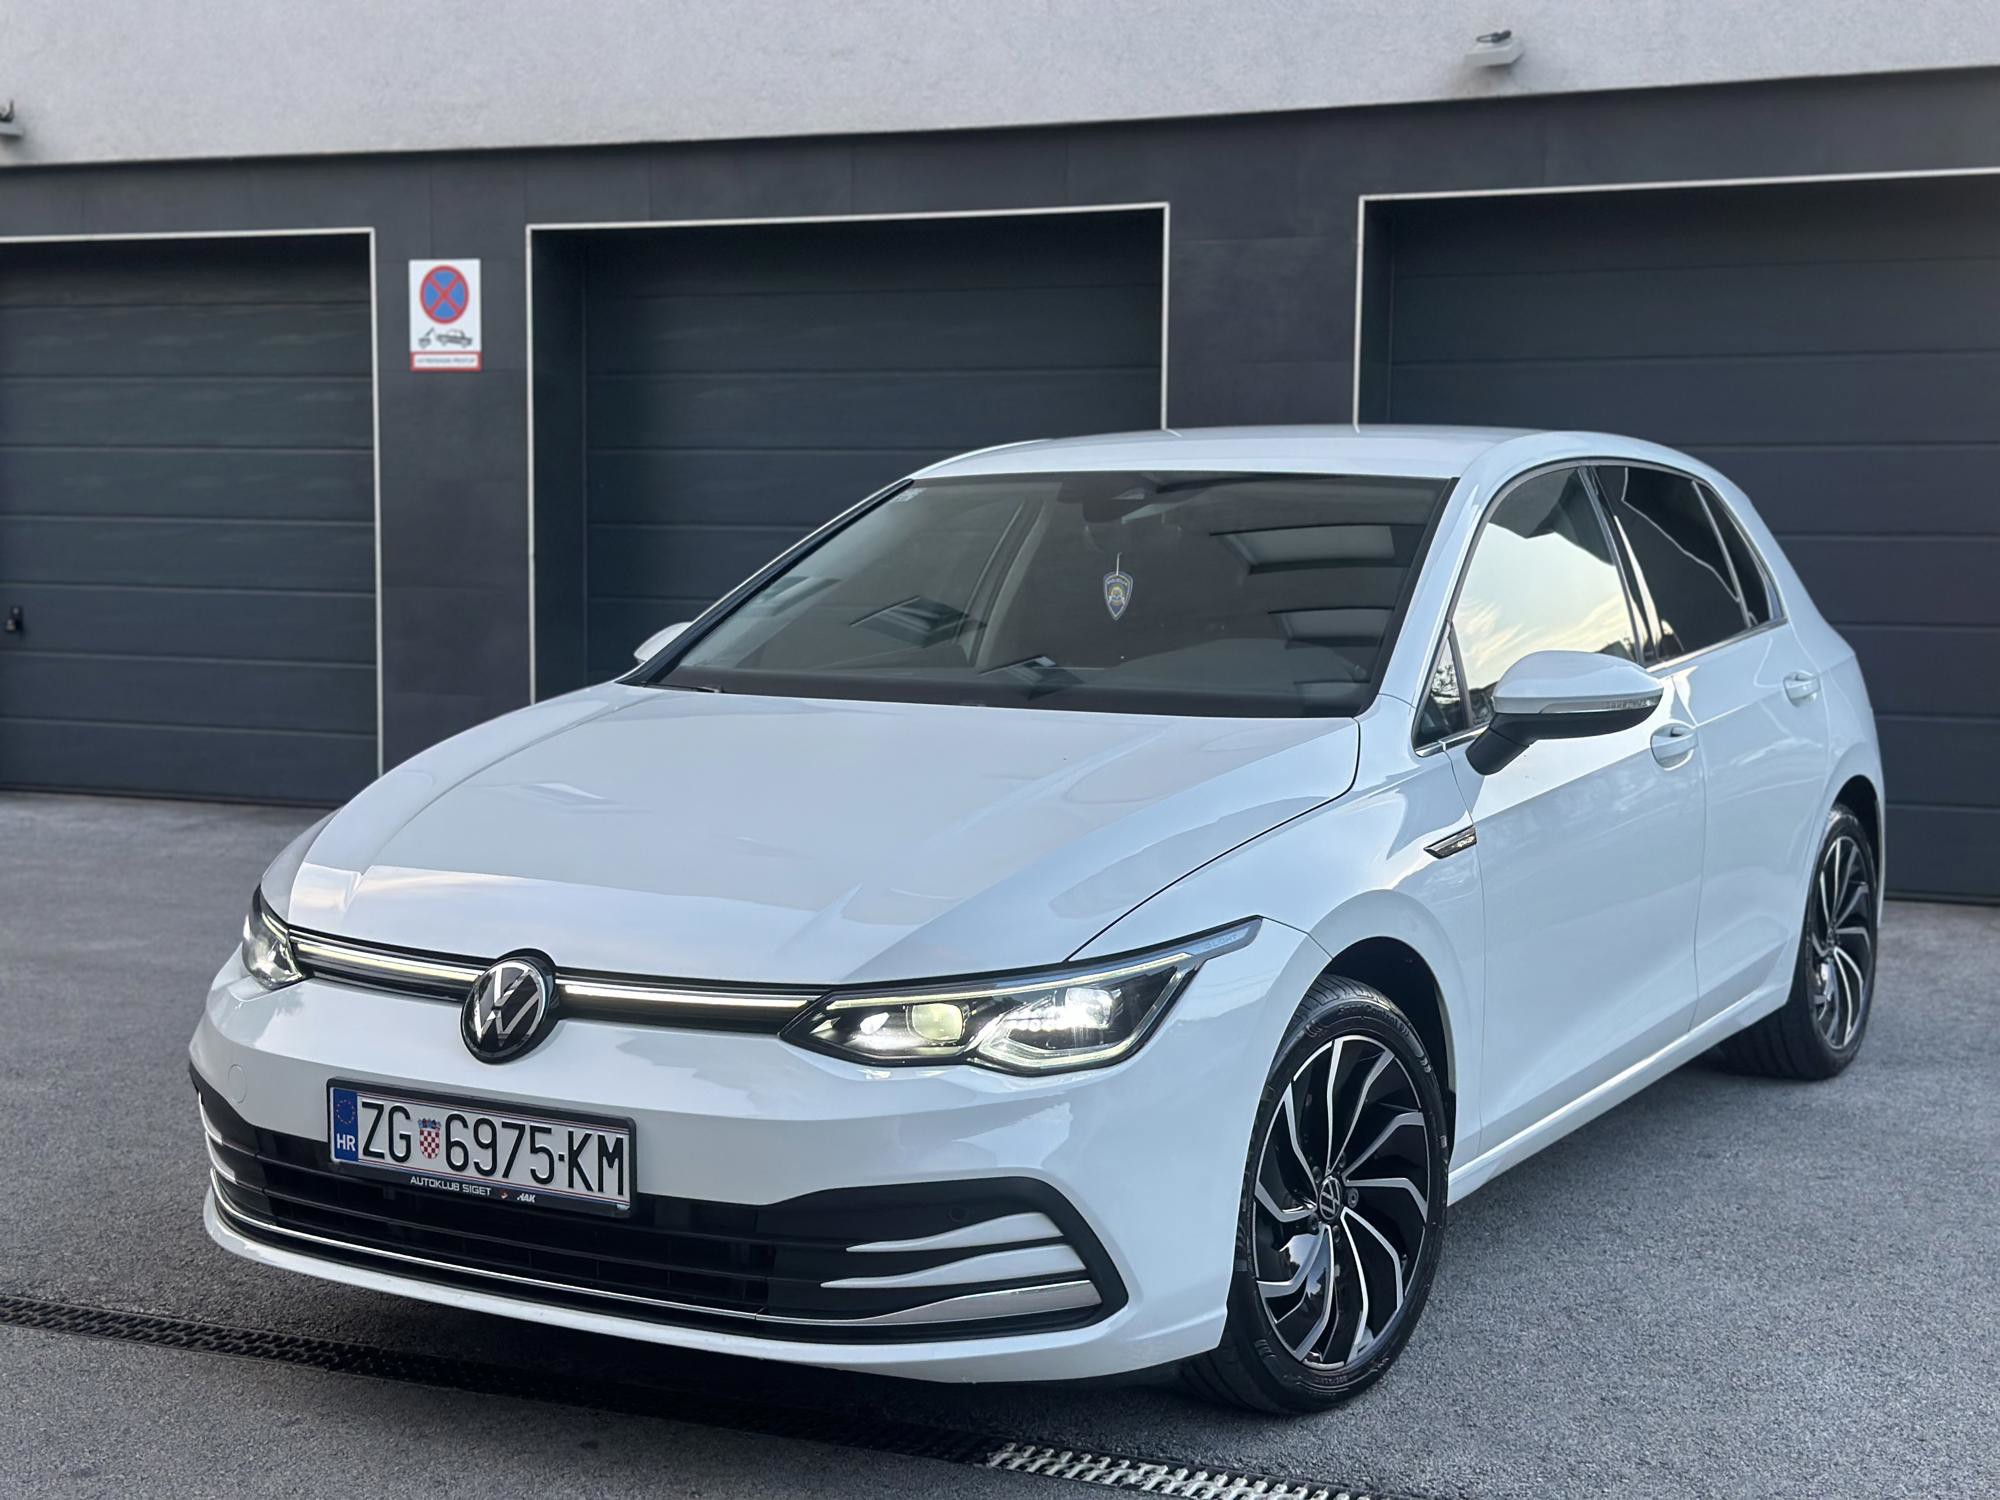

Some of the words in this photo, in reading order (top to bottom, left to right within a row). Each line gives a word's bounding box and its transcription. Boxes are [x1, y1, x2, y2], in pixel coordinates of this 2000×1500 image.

[361, 1101, 412, 1163] ZG
[336, 1133, 356, 1152] HR
[410, 1176, 460, 1192] AUTOKLUB
[462, 1183, 492, 1196] SIGET
